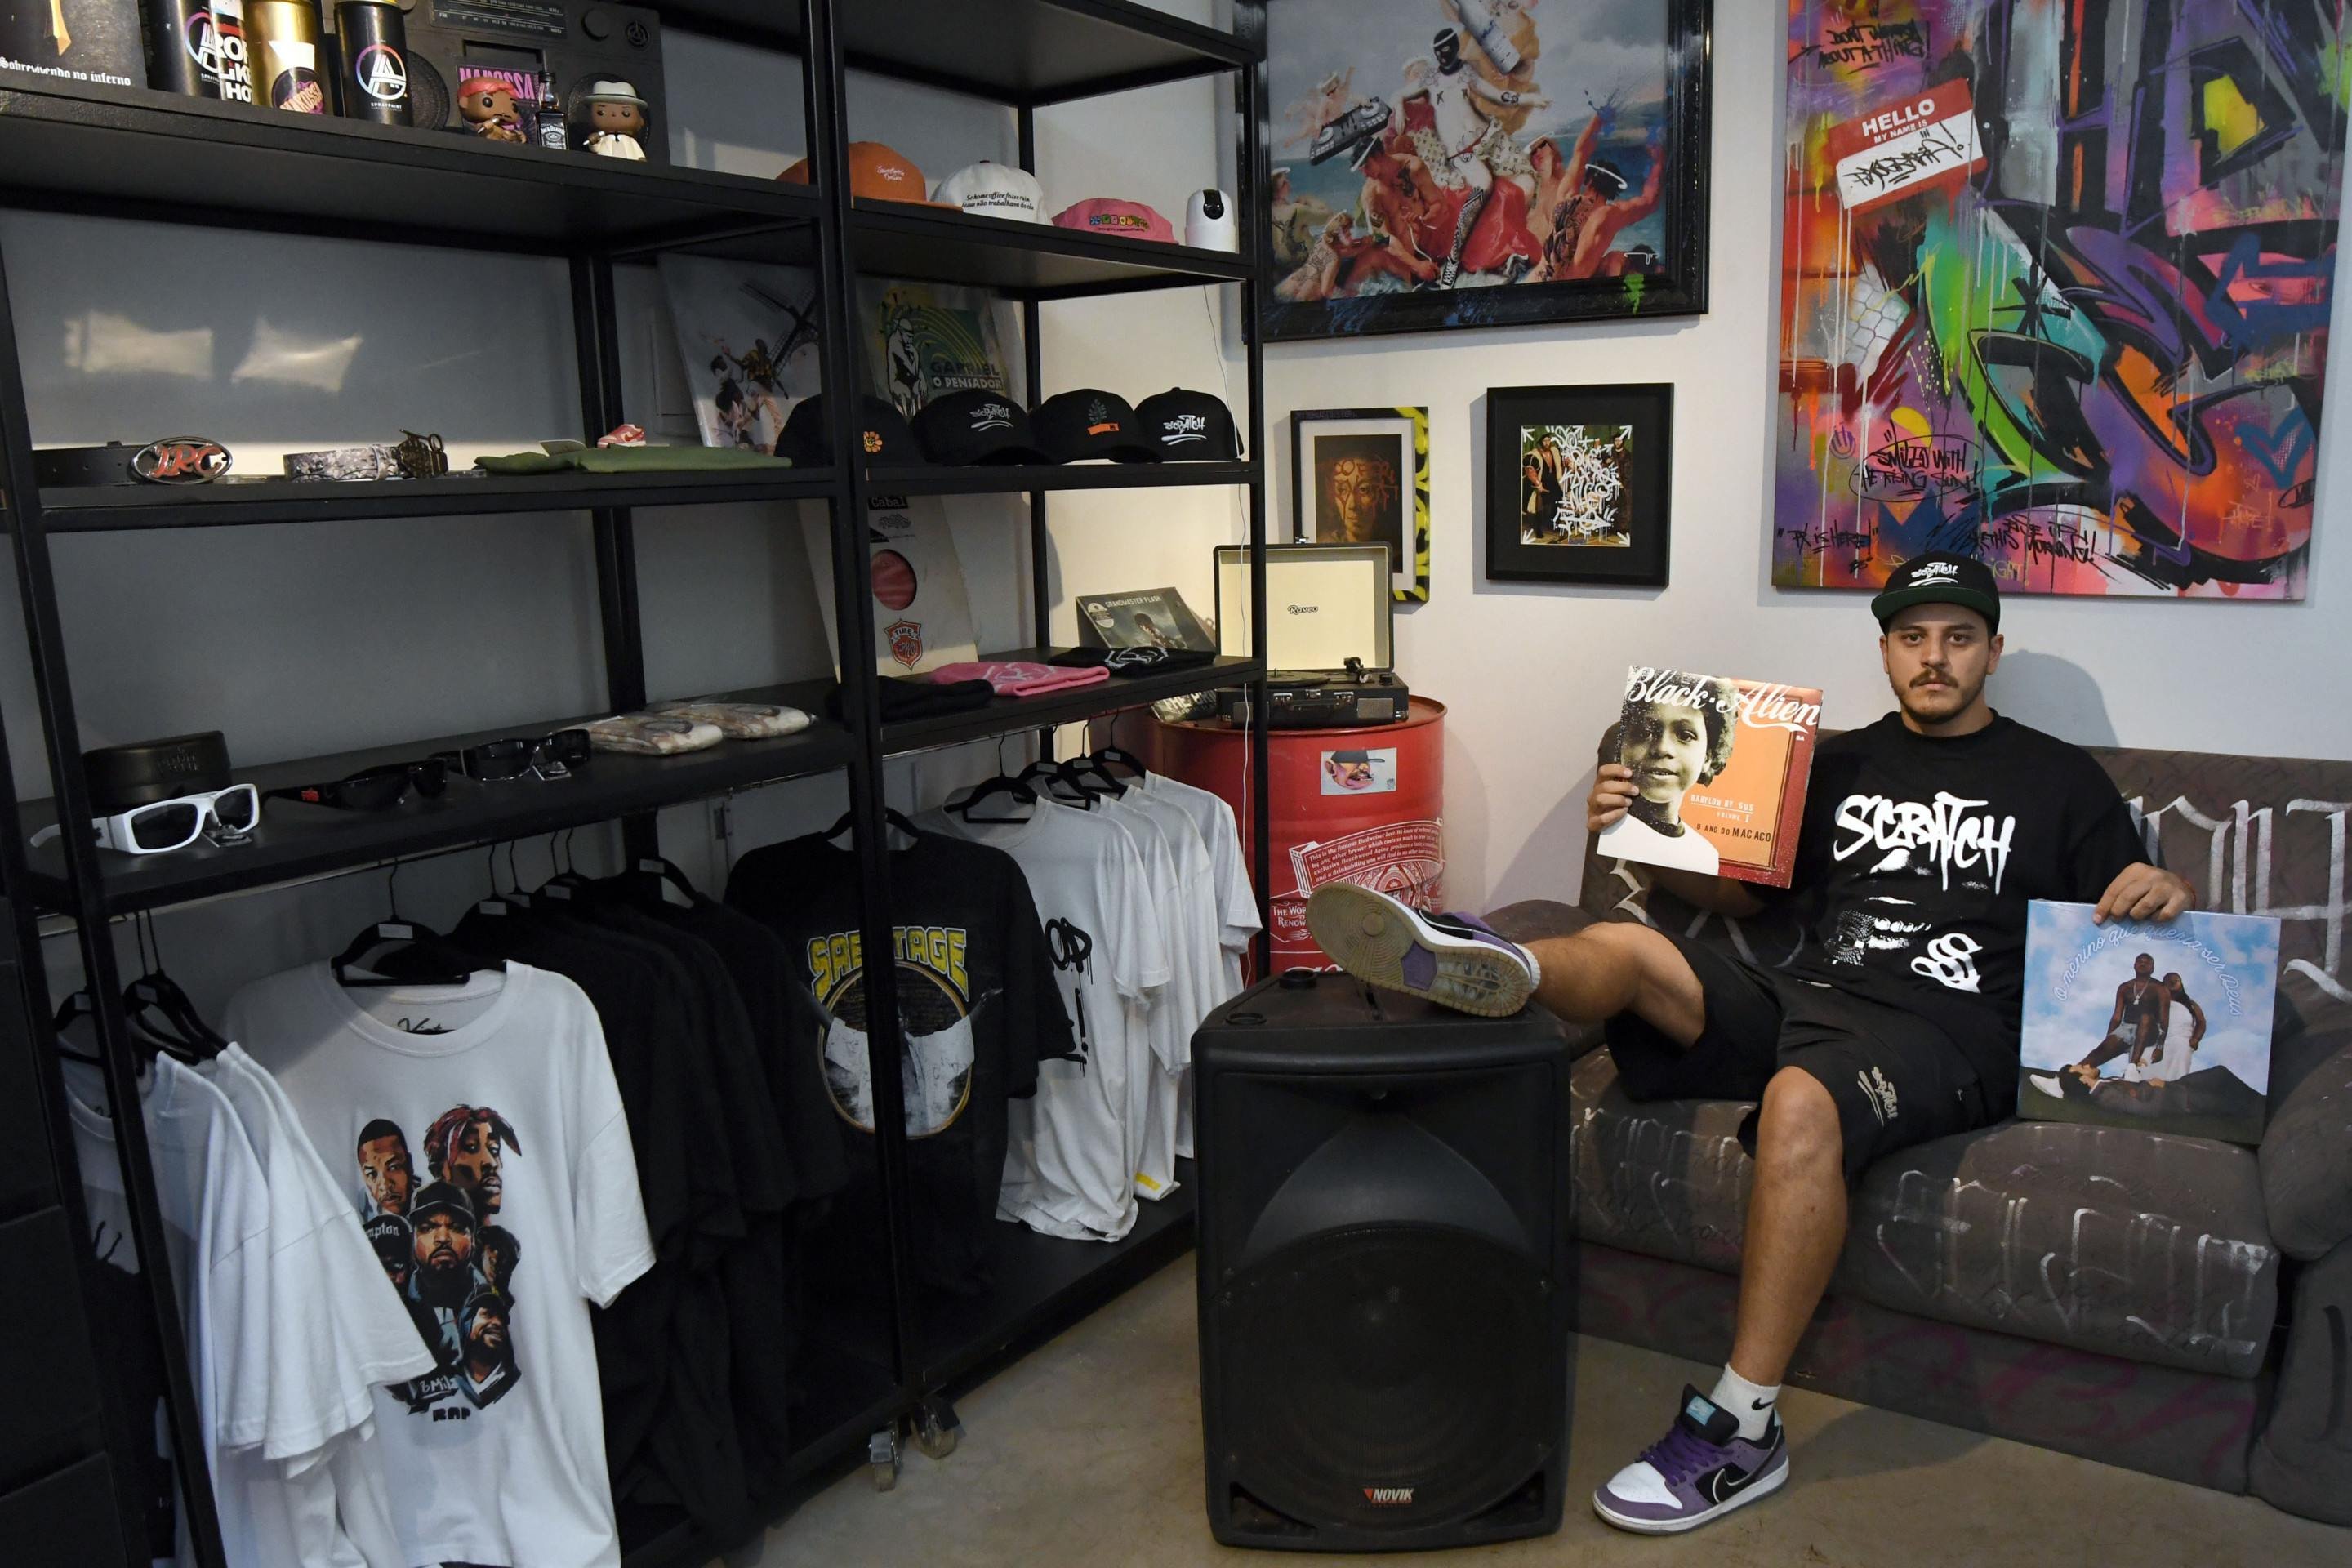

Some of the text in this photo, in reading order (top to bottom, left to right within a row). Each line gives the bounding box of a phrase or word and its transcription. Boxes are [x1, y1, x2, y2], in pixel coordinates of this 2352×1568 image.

[0, 56, 131, 87] Sobrevivendo no inferno
[225, 81, 252, 103] HO
[1862, 98, 1936, 136] HELLO
[1873, 118, 1928, 144] MY NAME IS
[988, 191, 1005, 200] office
[933, 377, 1002, 390] O PENSADOR
[1105, 597, 1143, 608] GRANDMASTER
[1624, 666, 1820, 729] Black Alien
[1690, 794, 1754, 812] BABYLON BY GUS
[1717, 812, 1740, 822] VOLUME
[1310, 853, 1321, 862] This
[1328, 848, 1337, 856] the
[1338, 841, 1357, 853] famous
[1358, 834, 1384, 845] Budweiser
[1332, 852, 1348, 862] other
[1348, 845, 1368, 857] brewer
[1369, 840, 1383, 849] which
[1833, 791, 2016, 895] SCRATCH
[1313, 862, 1340, 875] exclusive
[1341, 850, 1373, 865] Beechwood
[1316, 874, 1327, 883] and
[1332, 860, 1365, 875] drinkability
[1377, 853, 1386, 862] will
[1272, 906, 1307, 916] THE WOR
[1278, 916, 1307, 928] RENOW
[808, 926, 969, 1003] SABTAGE
[2062, 935, 2105, 988] menino
[2109, 925, 2138, 947] que
[2143, 924, 2202, 953] queria
[2201, 947, 2225, 973] ser
[366, 1222, 399, 1240] mpton
[433, 1406, 471, 1422] RAP
[1373, 1488, 1414, 1503] NOVIK
